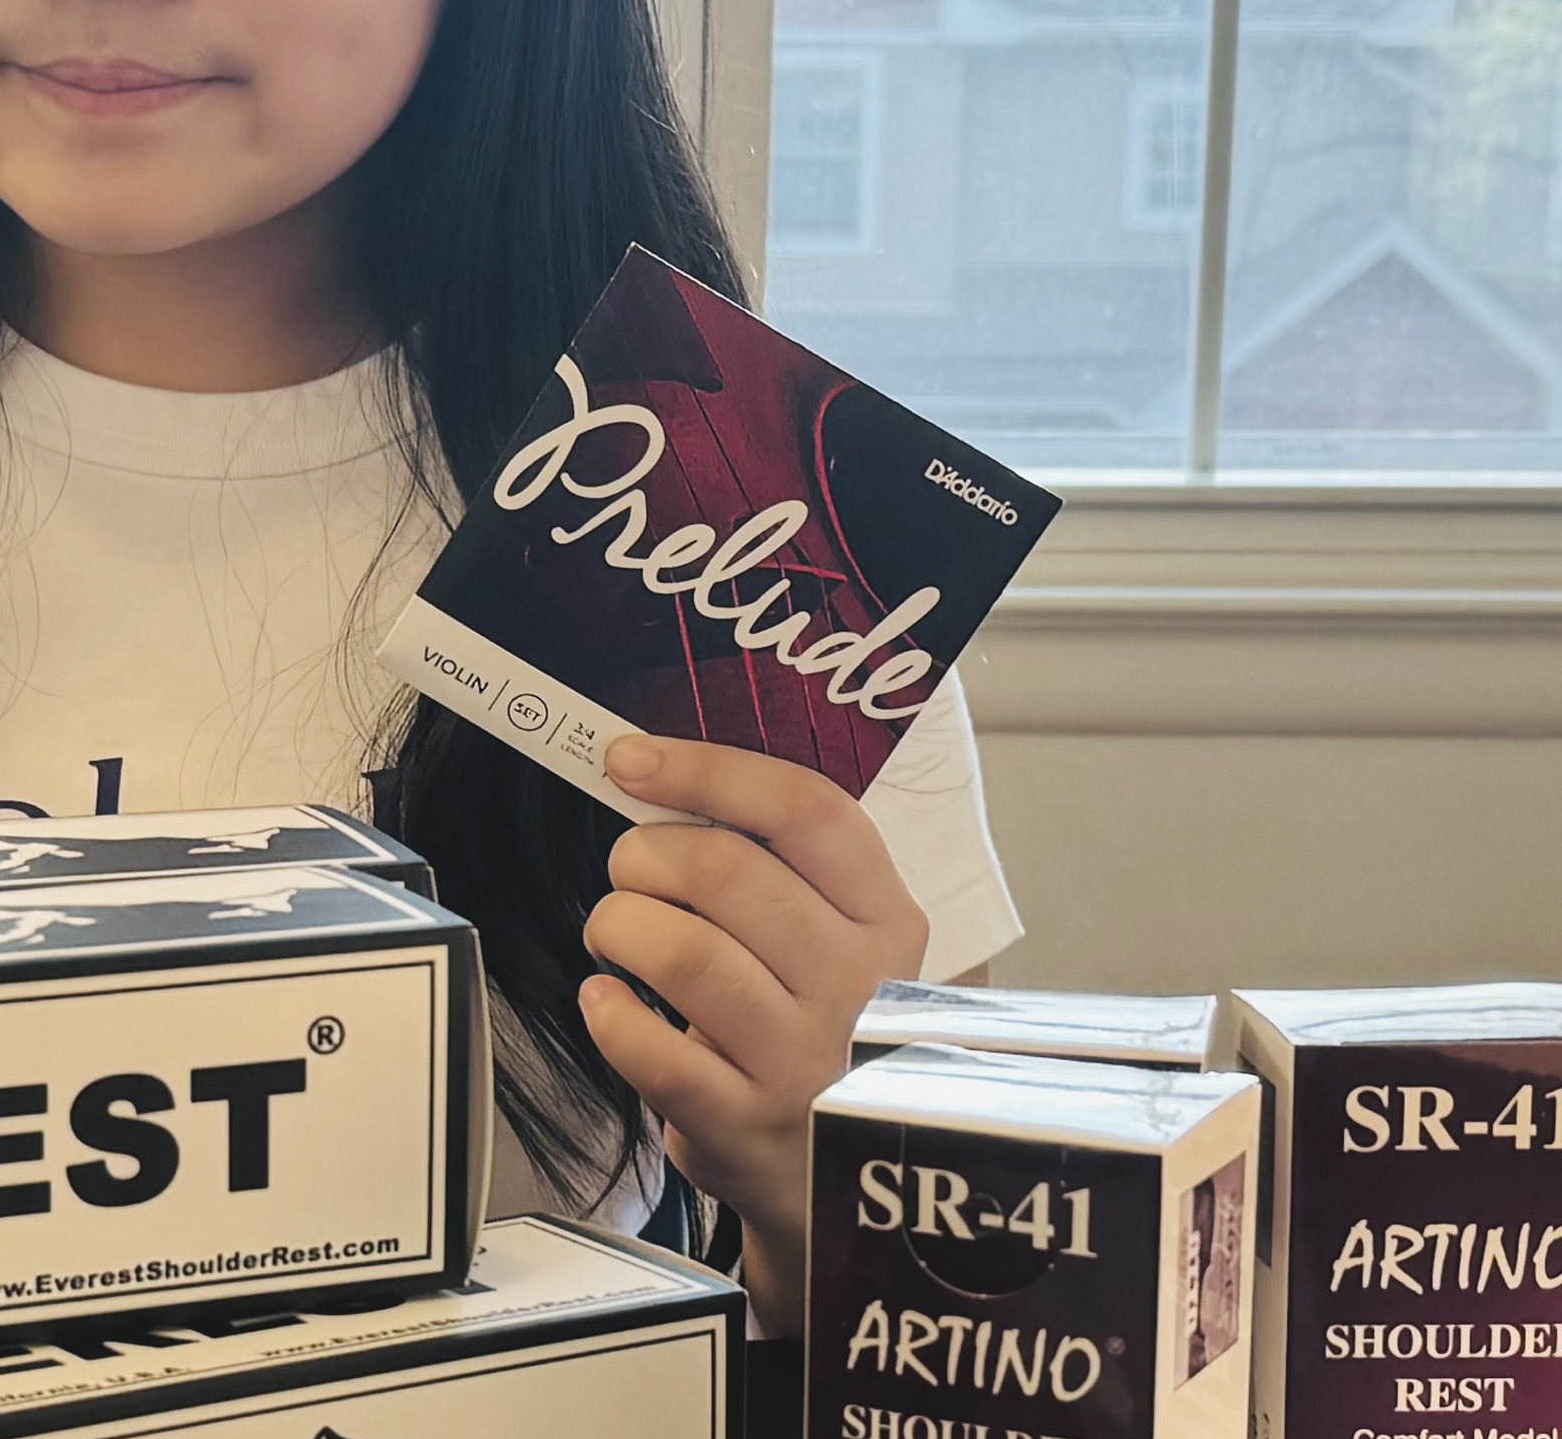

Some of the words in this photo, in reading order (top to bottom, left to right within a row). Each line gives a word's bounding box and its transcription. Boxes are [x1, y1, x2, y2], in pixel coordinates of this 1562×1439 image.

[493, 352, 942, 722] Prelude
[922, 457, 1019, 528] D'Addario
[421, 643, 490, 698] VIOLIN
[513, 697, 543, 725] SET
[856, 1158, 1100, 1260] SR-41
[847, 1297, 1102, 1404] ARTINO
[1394, 1376, 1515, 1413] REST
